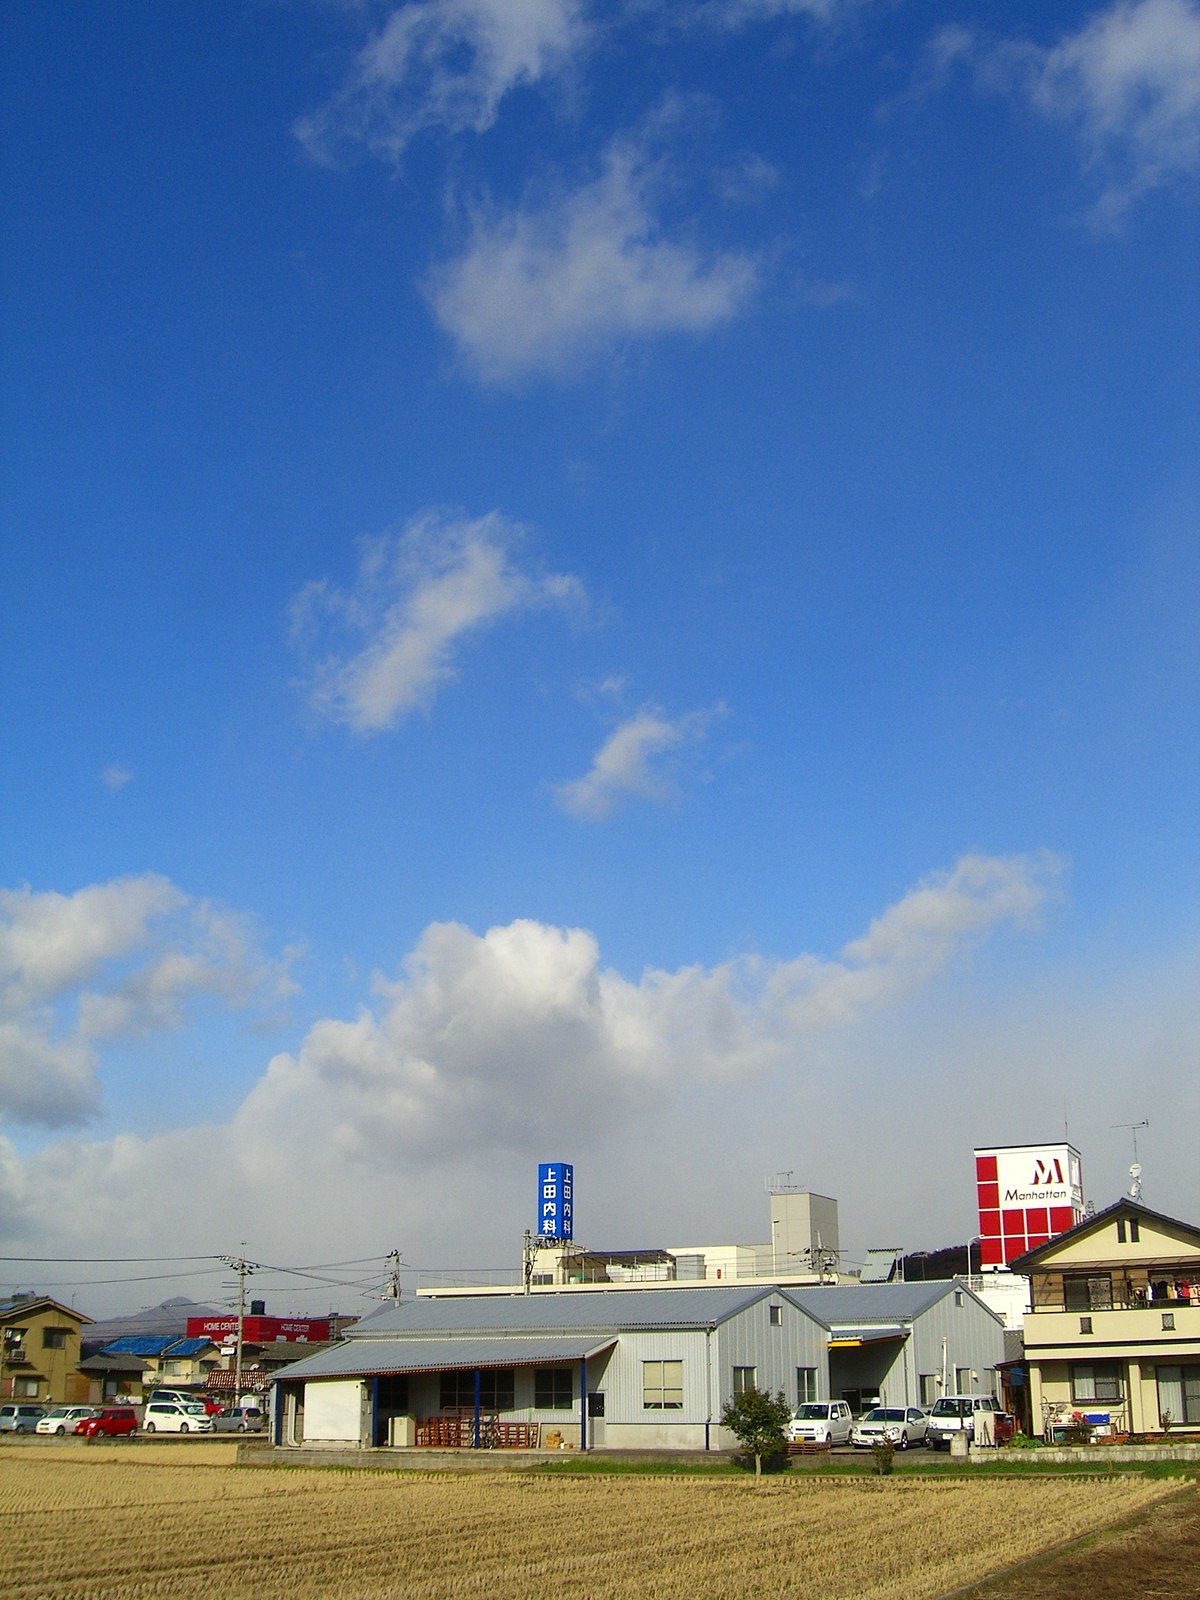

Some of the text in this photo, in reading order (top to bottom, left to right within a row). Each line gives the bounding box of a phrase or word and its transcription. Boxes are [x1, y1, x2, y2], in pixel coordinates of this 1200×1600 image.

[543, 1168, 557, 1234] 上田内科
[563, 1168, 571, 1234] 上田内科
[1005, 1190, 1066, 1201] Manhattan
[281, 1323, 309, 1332] HOME CENTER
